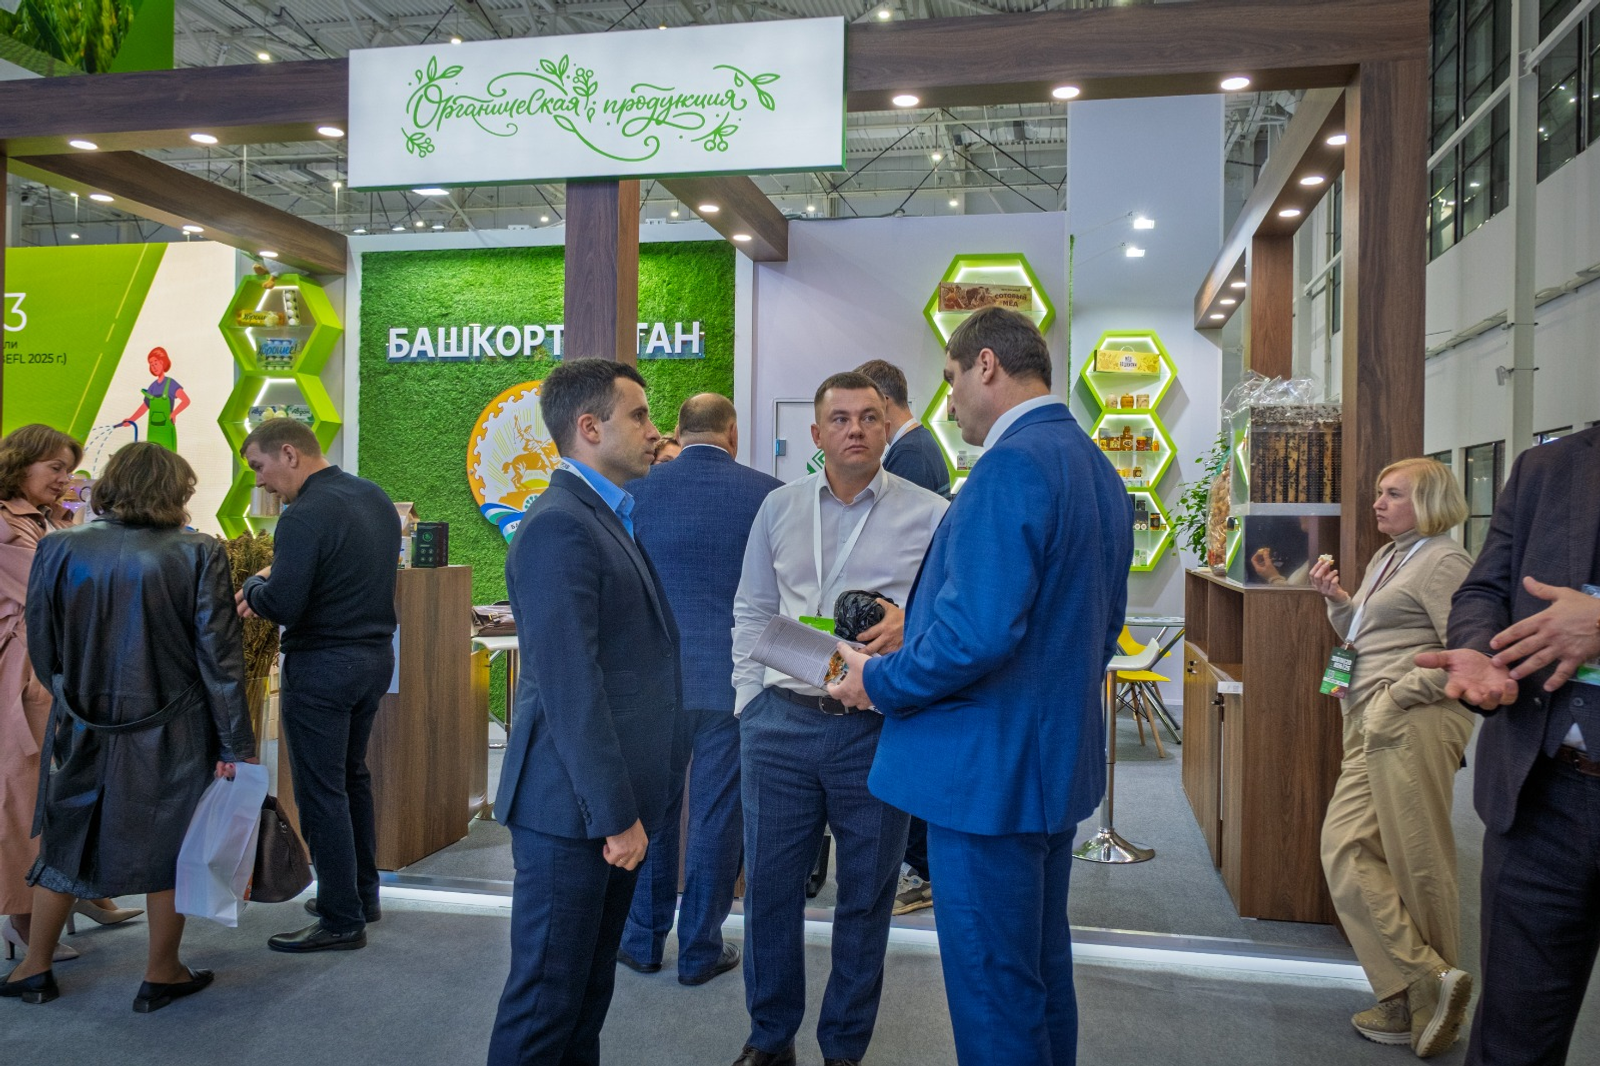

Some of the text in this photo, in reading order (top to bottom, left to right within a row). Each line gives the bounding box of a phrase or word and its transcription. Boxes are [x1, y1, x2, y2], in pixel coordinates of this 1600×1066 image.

[603, 83, 748, 138] продукция
[389, 321, 700, 358] БАШКОРТАН
[3, 352, 67, 366] EFL 2025 г.)
